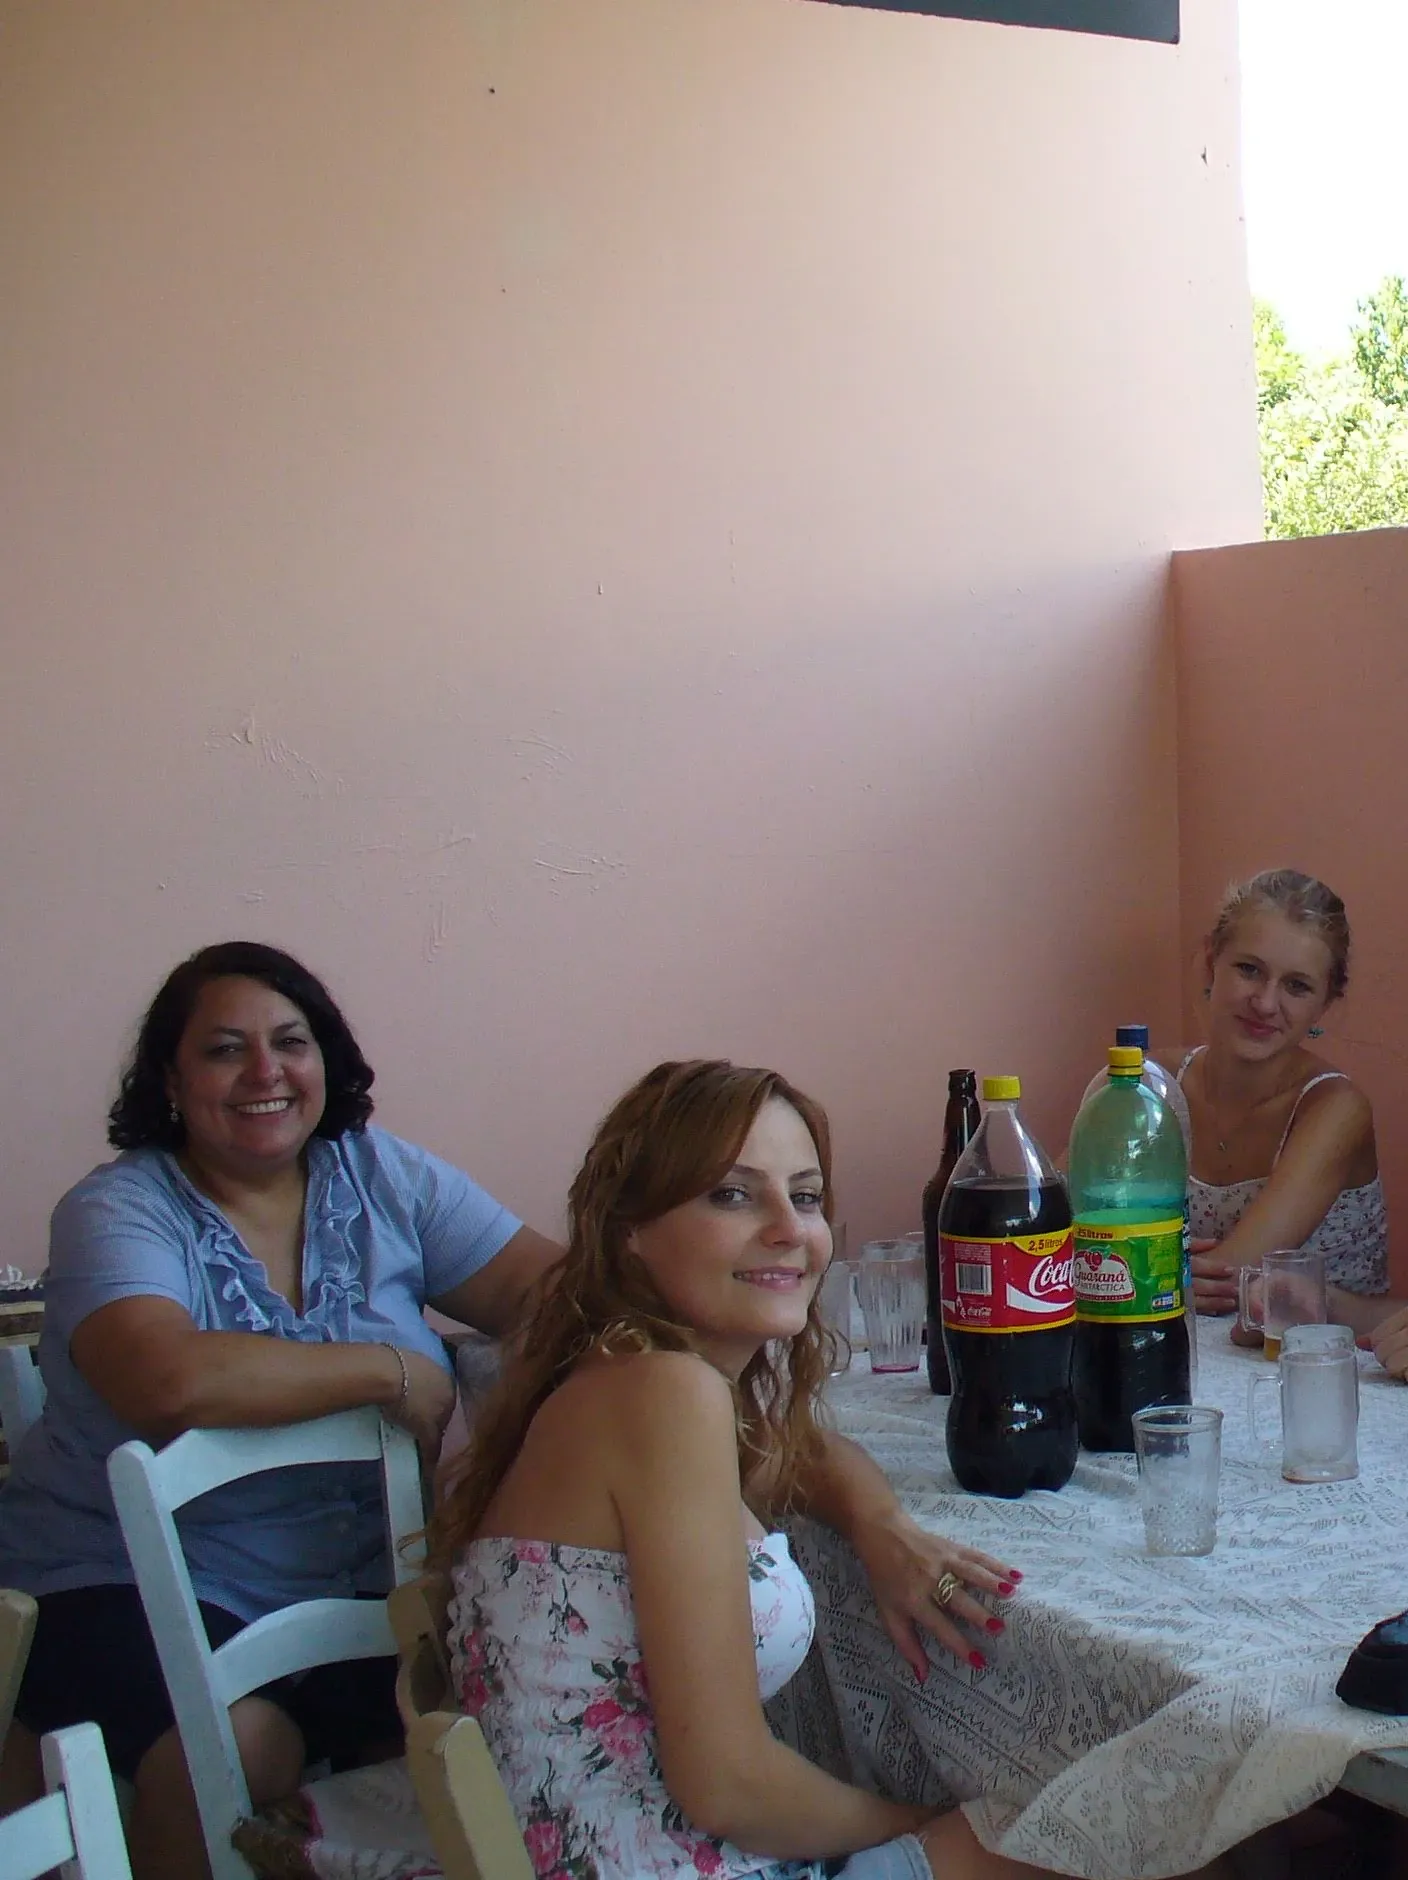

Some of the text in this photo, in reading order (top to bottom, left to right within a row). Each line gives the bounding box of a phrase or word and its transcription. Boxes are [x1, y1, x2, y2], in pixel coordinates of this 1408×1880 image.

[1028, 1238, 1064, 1252] 2,5 litros
[1074, 1261, 1127, 1283] Guaraná
